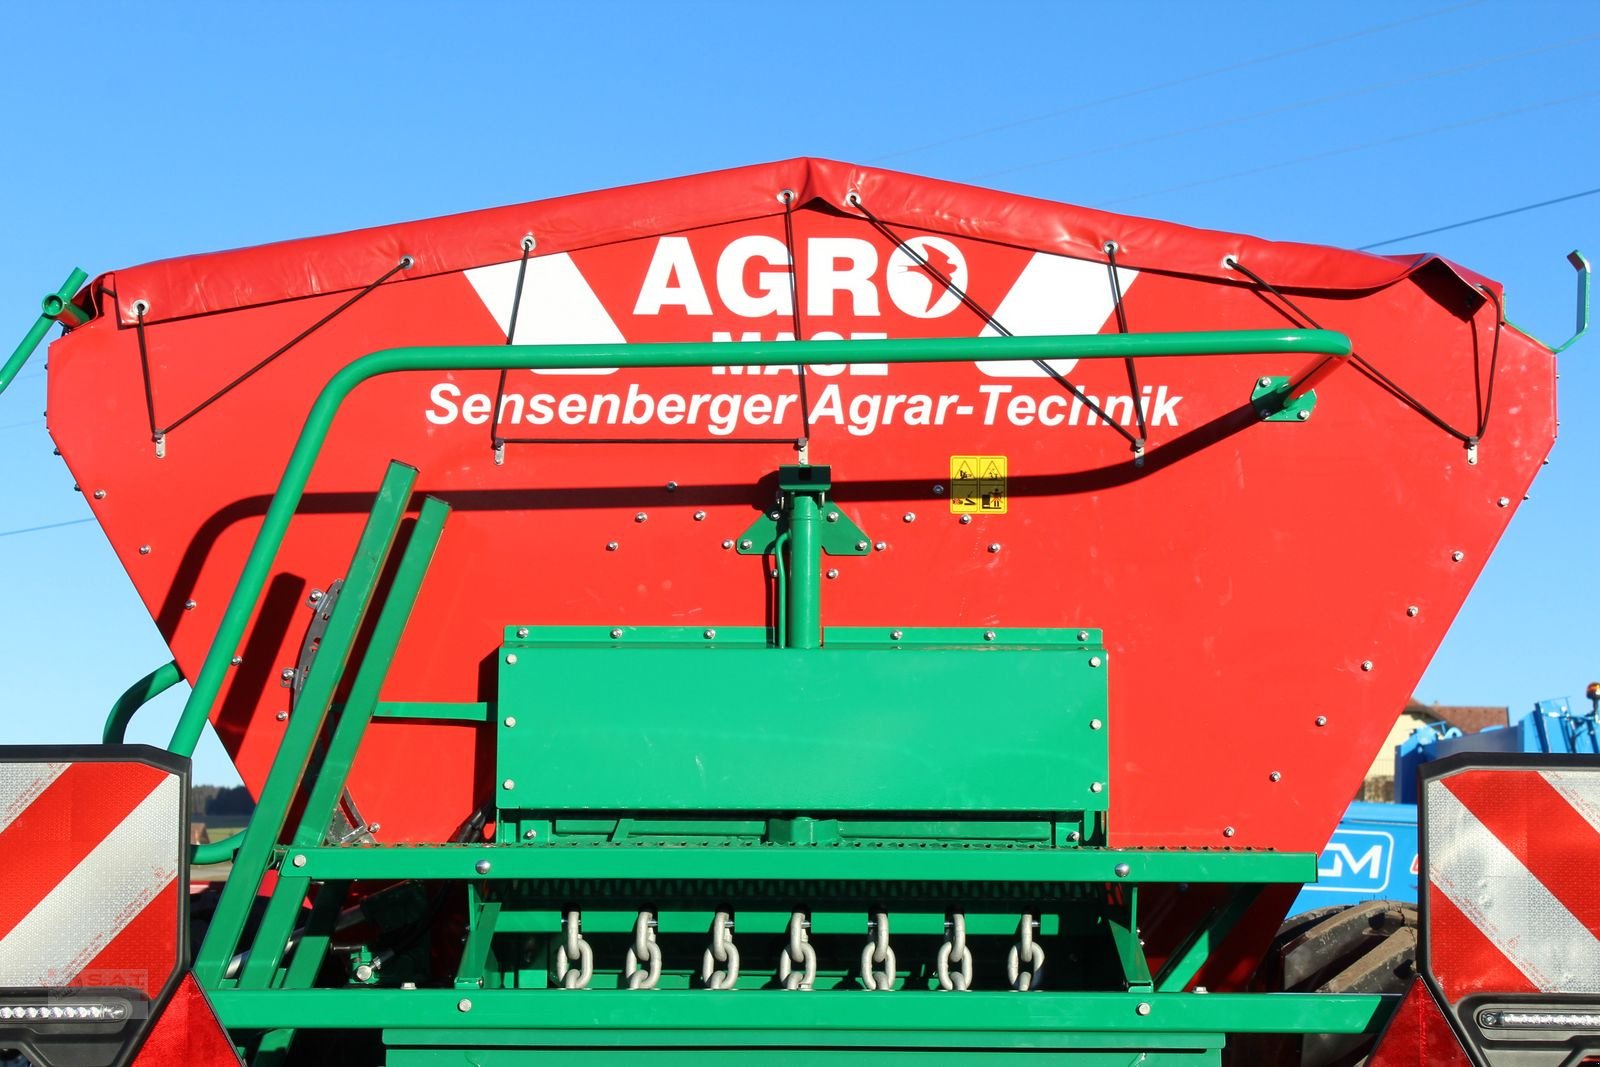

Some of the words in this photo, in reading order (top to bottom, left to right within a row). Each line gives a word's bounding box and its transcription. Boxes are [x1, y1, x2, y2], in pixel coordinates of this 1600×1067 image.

[633, 235, 968, 319] AGRO
[425, 382, 799, 436] Sensenberger
[807, 383, 1183, 437] Agrar-Technik
